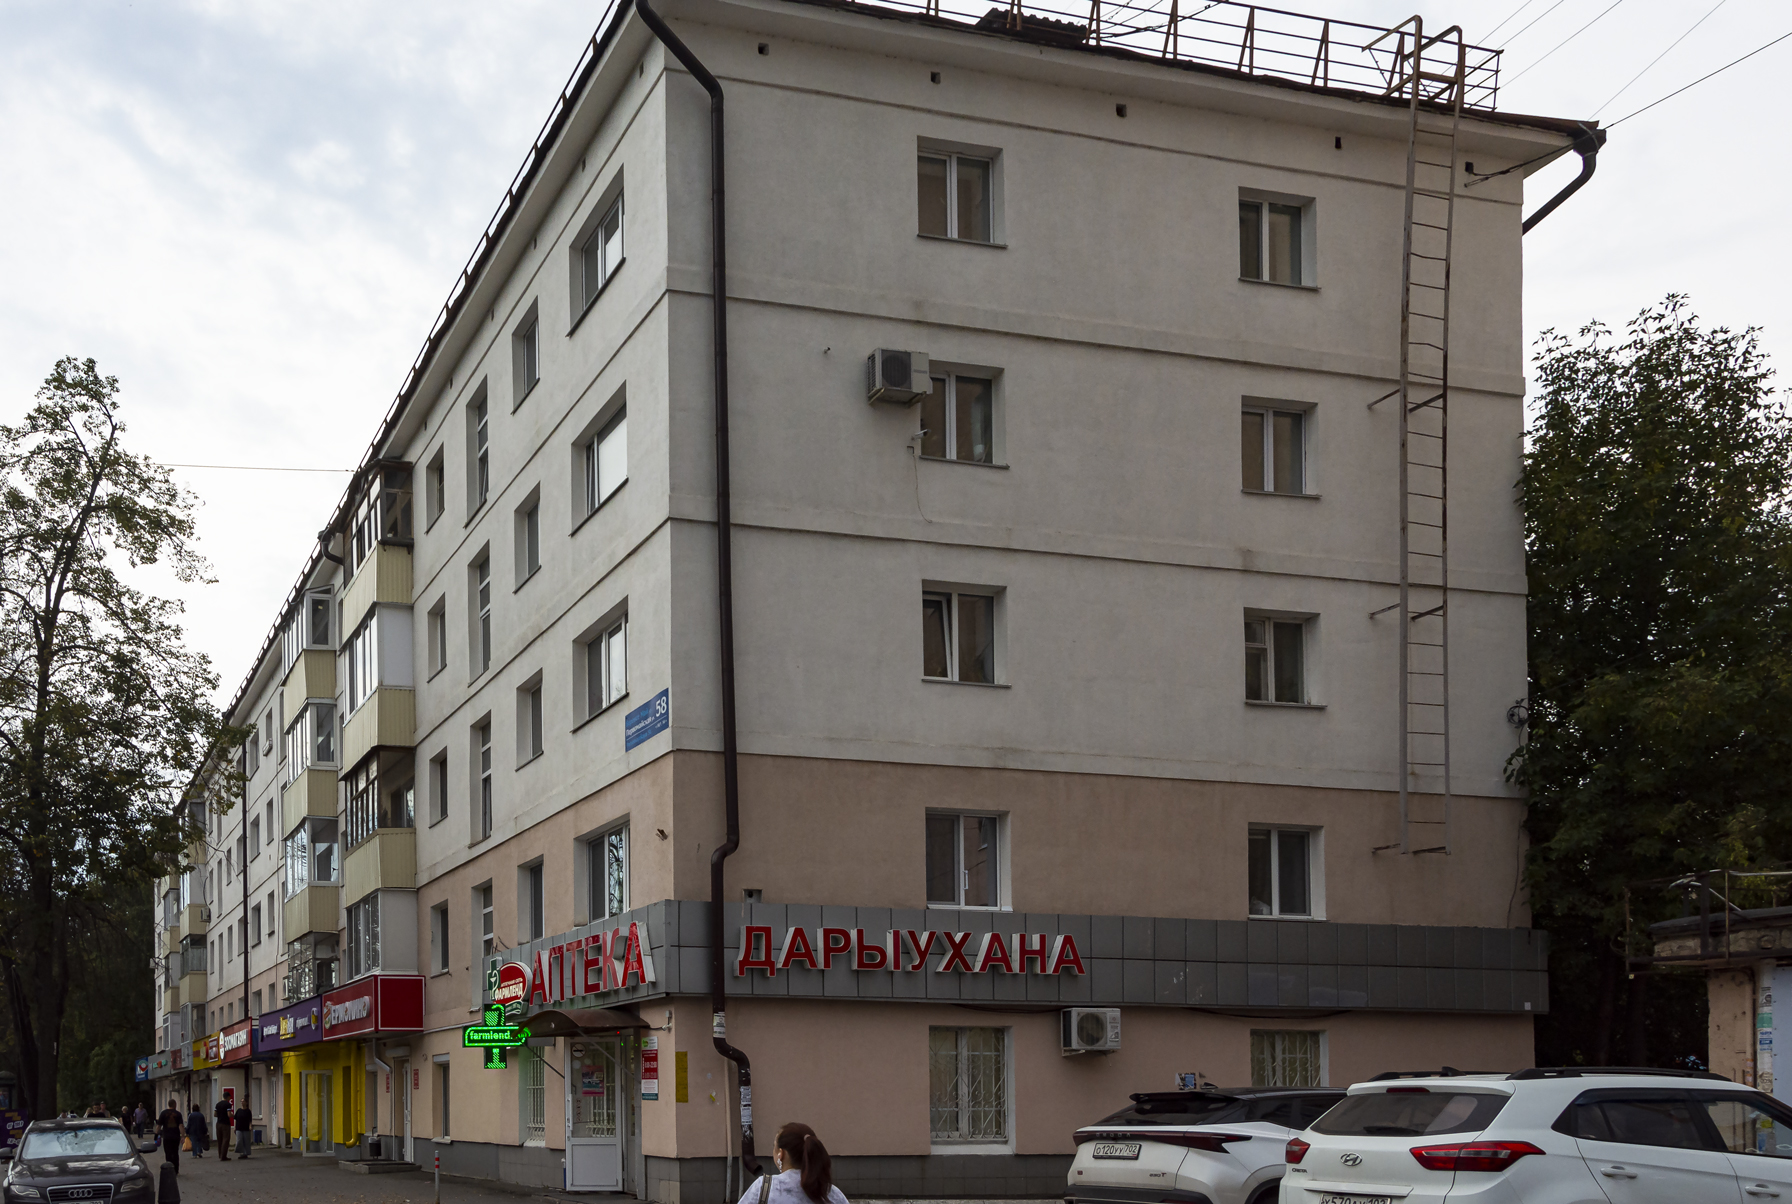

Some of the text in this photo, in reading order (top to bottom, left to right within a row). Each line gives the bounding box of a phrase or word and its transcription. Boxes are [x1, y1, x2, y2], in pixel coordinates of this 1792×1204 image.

[656, 696, 667, 717] 58
[529, 921, 647, 1006] АПТЕКА
[736, 925, 1086, 977] ДАРЫУХАНА
